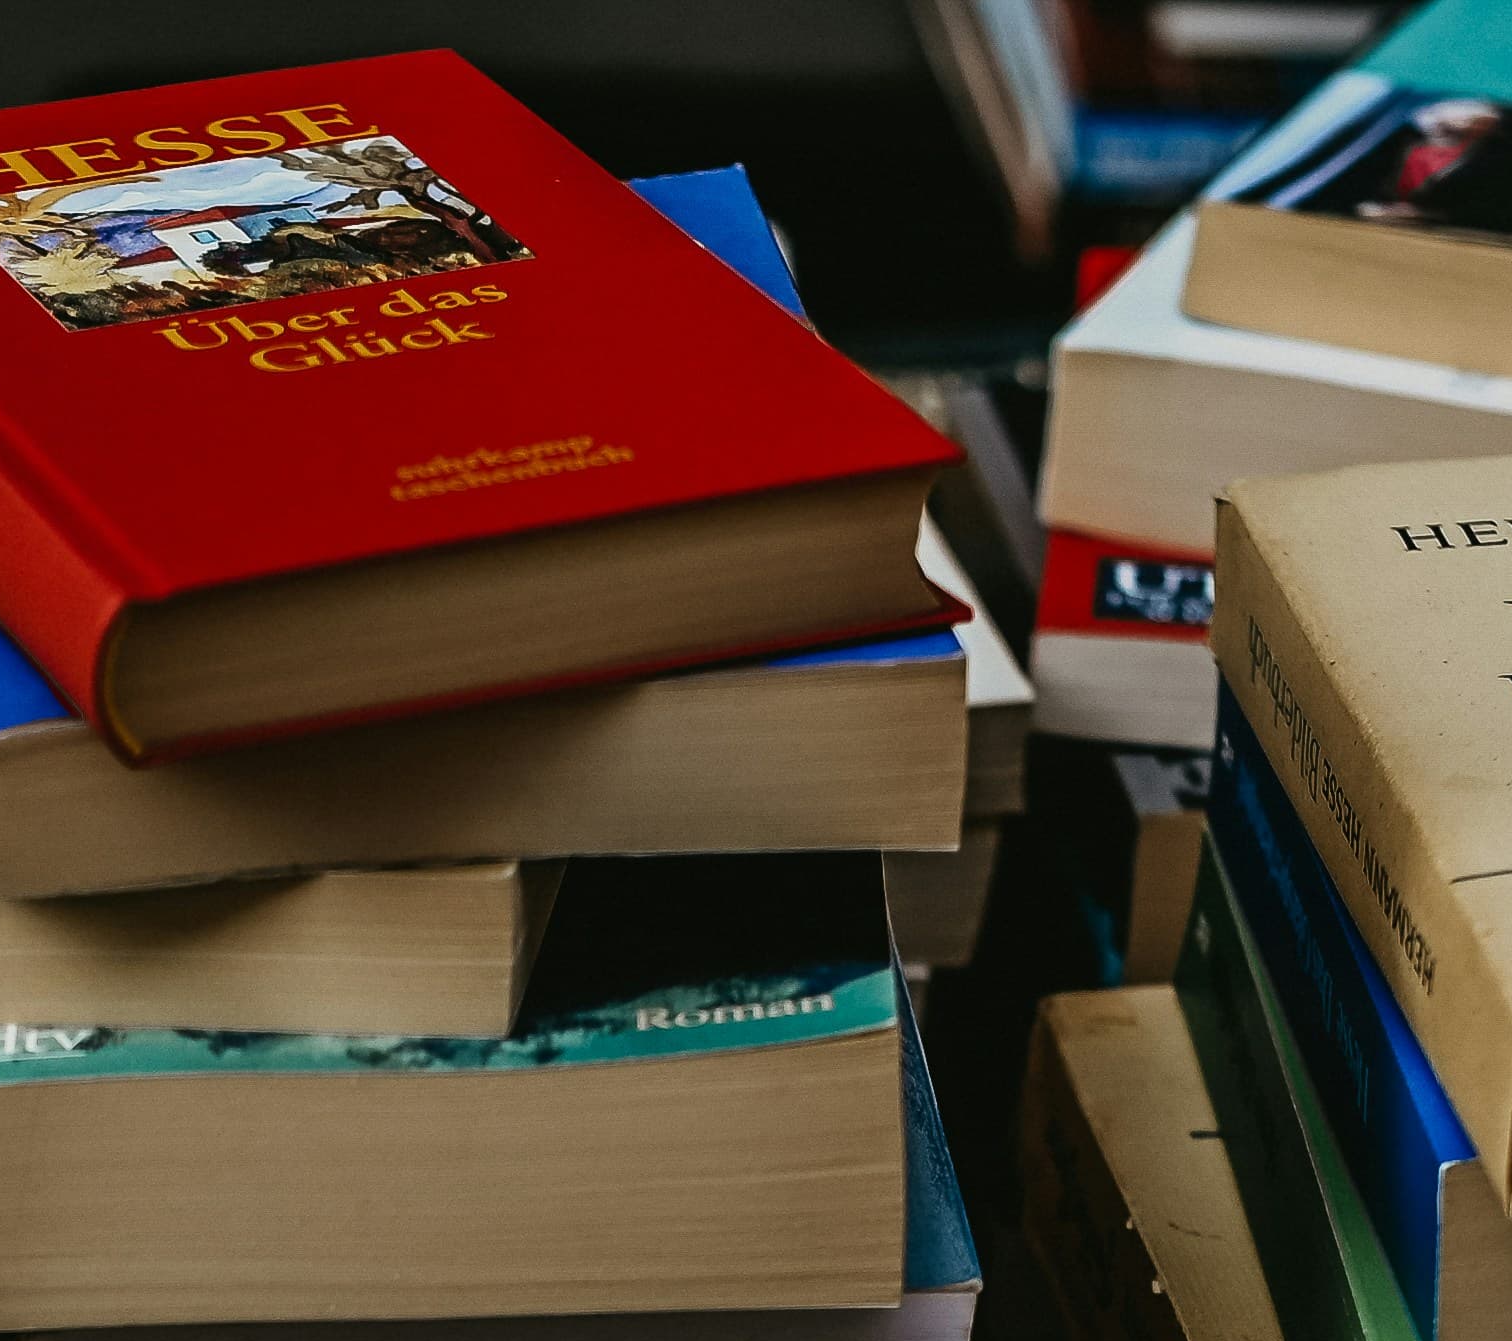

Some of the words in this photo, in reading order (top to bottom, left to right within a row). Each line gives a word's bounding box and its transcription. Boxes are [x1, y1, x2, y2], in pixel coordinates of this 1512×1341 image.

[153, 303, 361, 352] Über
[378, 284, 509, 318] das
[248, 317, 495, 373] Glück
[1248, 615, 1323, 804] Bilderbuch
[1321, 757, 1364, 860] HESSE
[1363, 839, 1437, 997] HERMANN
[634, 987, 836, 1036] Roman
